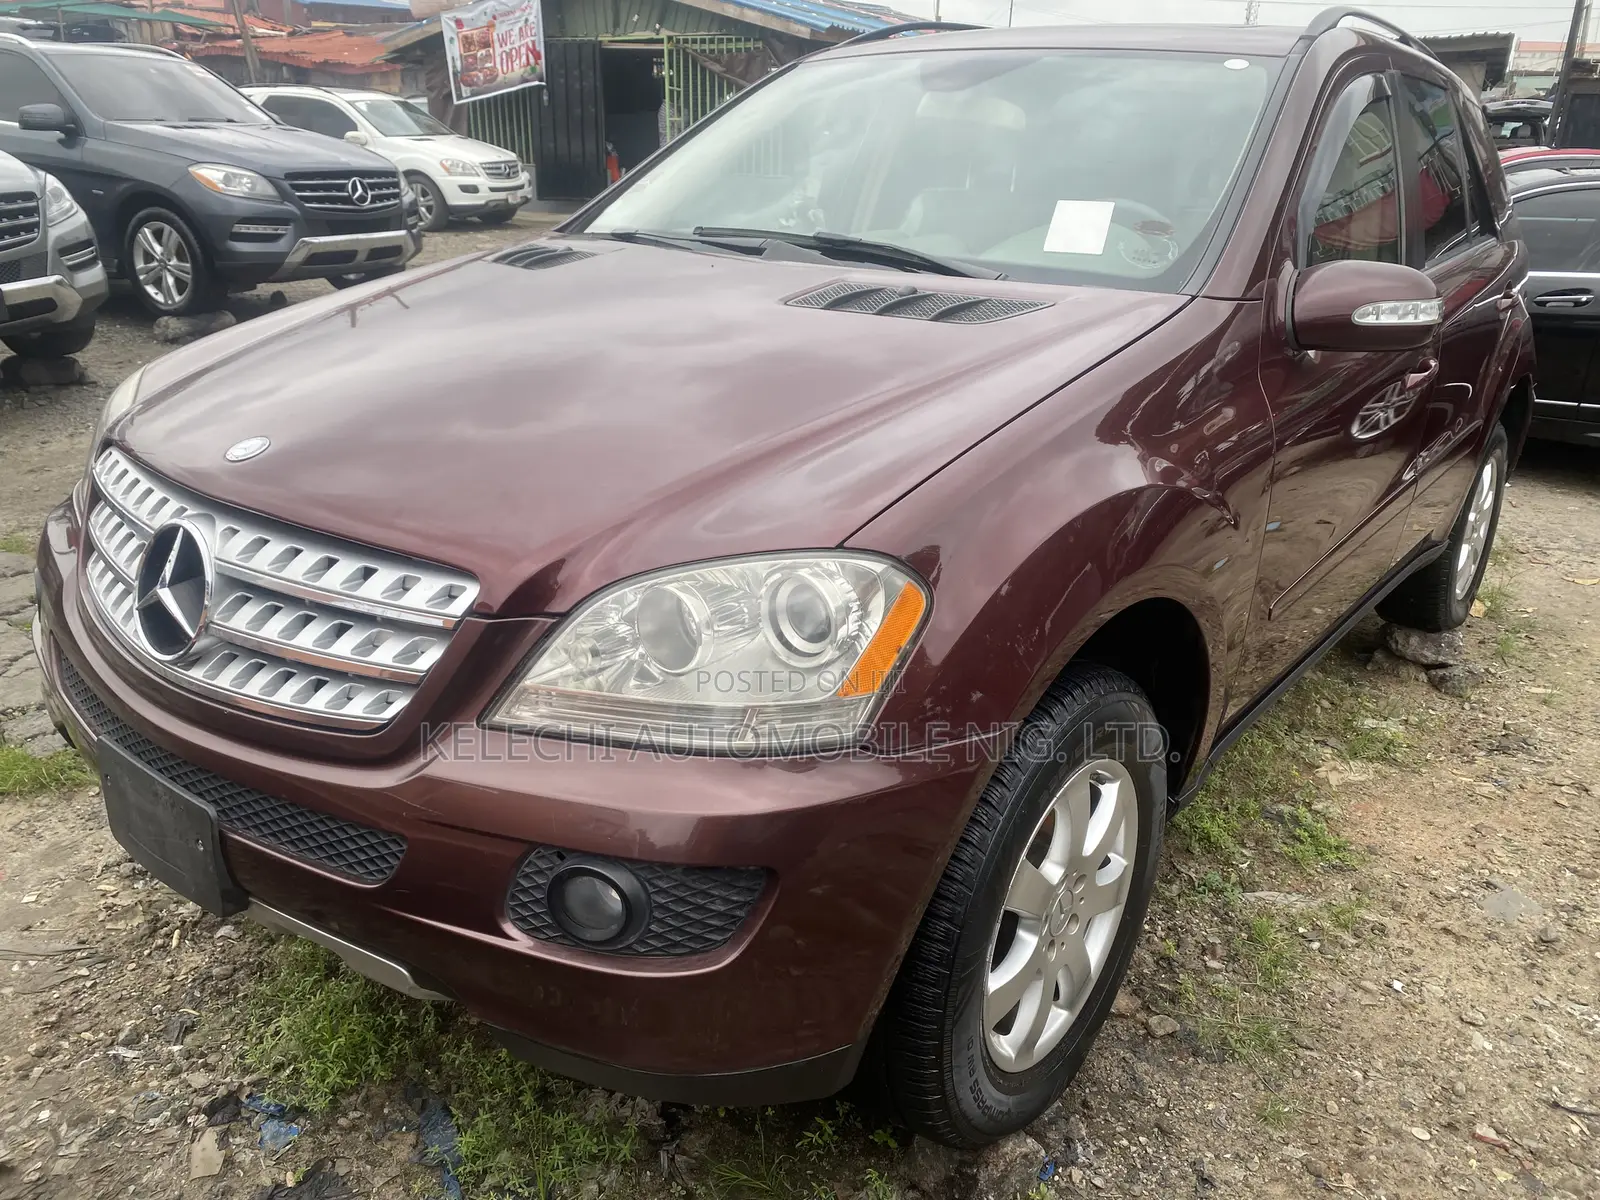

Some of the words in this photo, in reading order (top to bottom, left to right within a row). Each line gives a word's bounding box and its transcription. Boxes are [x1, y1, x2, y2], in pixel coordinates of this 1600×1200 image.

[497, 29, 515, 47] WE
[518, 23, 537, 40] ARE
[501, 41, 539, 74] OPEN
